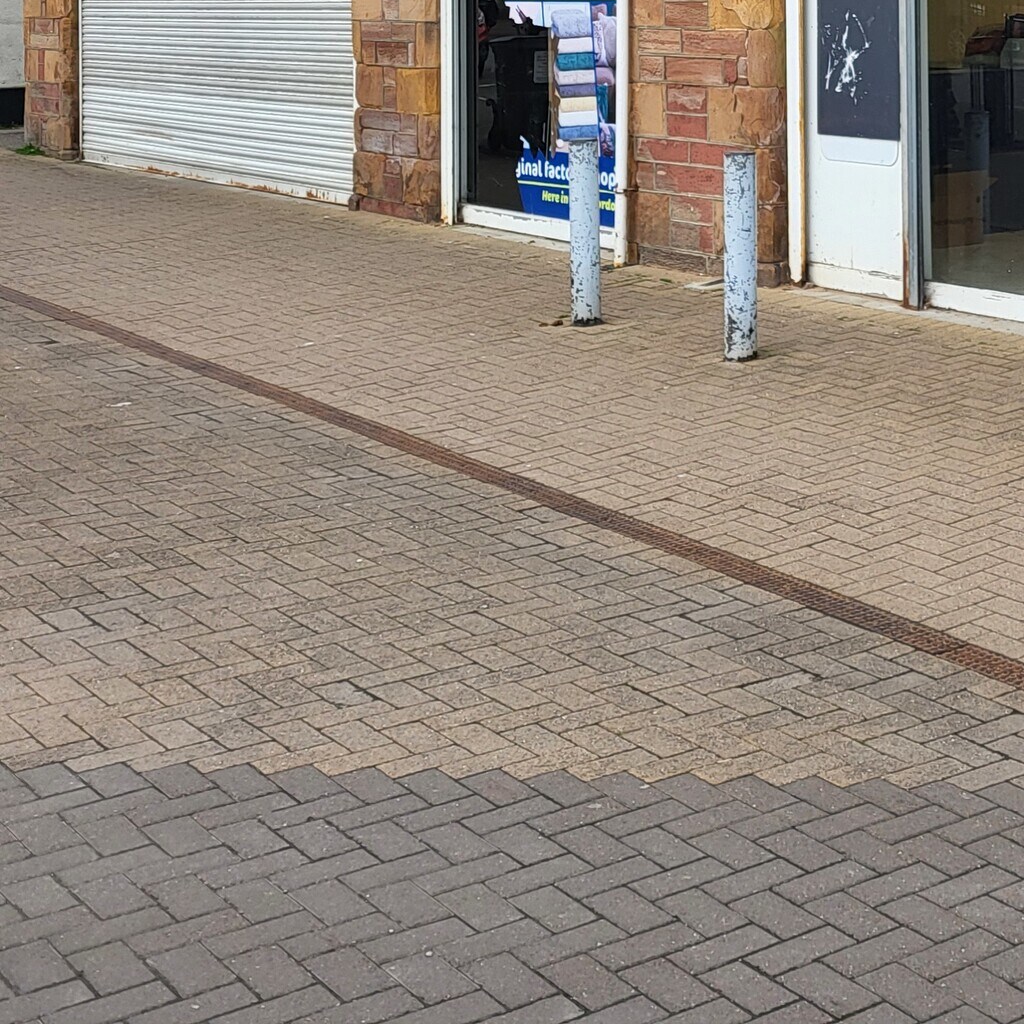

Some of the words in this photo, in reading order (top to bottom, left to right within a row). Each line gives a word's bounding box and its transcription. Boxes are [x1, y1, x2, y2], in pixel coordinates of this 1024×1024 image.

[515, 158, 543, 179] ginal
[544, 160, 569, 180] facto
[542, 190, 559, 203] Here
[559, 191, 568, 204] in
